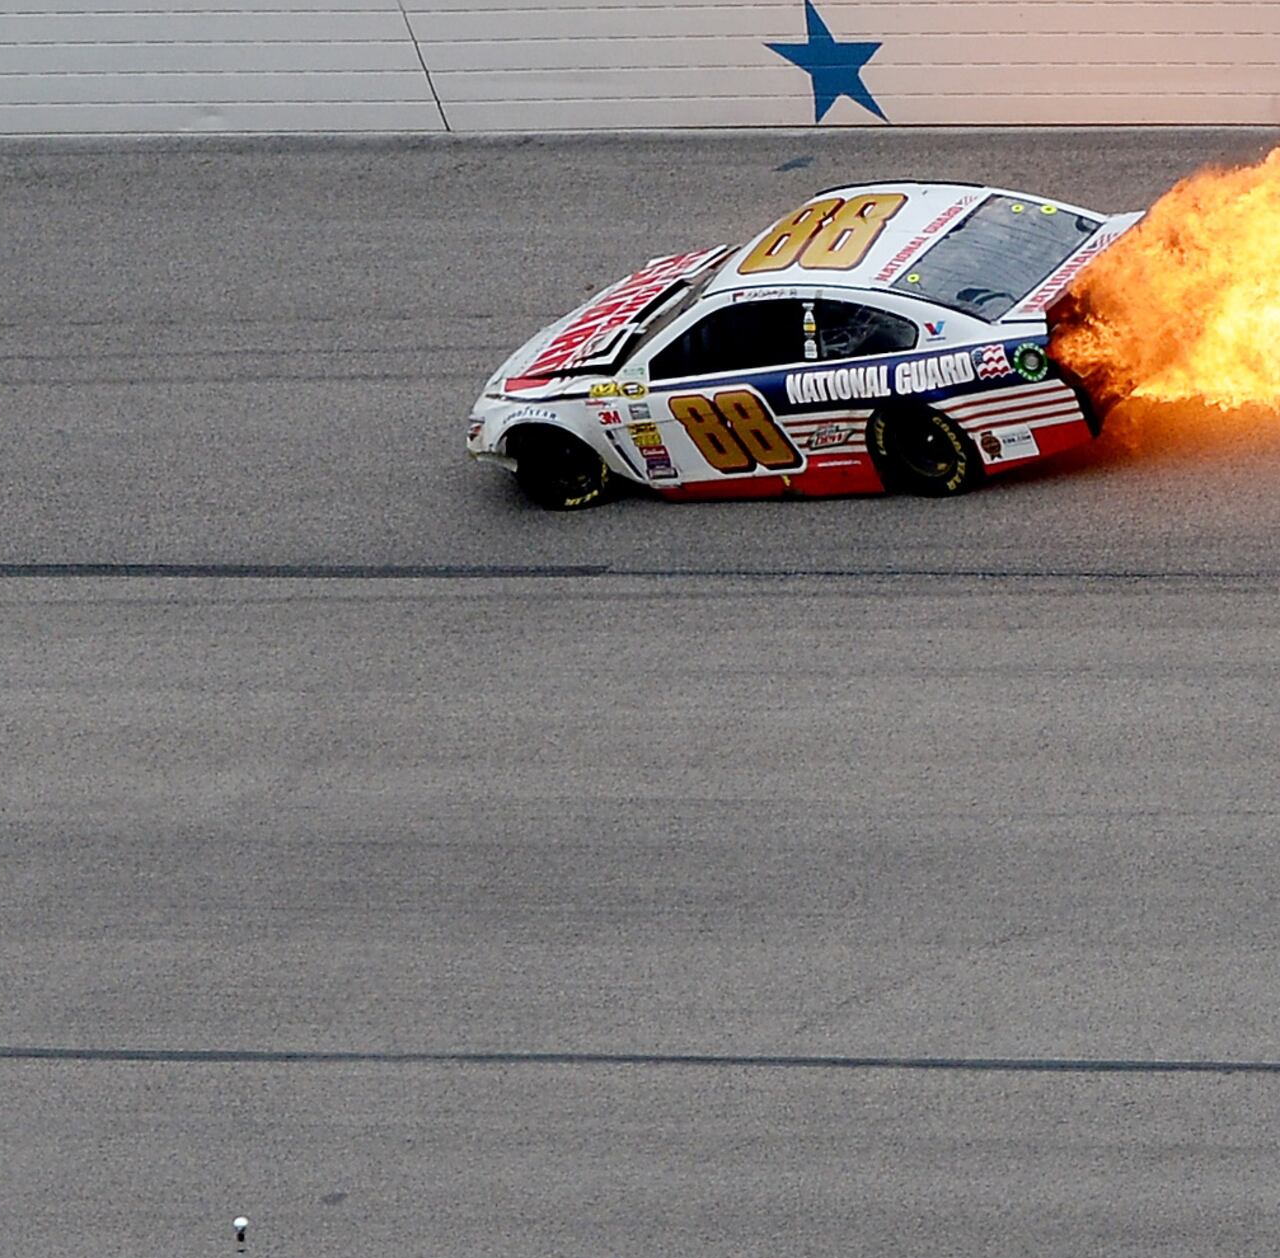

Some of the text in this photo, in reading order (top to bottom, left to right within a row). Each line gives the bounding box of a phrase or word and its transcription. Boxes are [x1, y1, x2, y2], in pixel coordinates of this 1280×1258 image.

[737, 194, 908, 275] 88
[874, 205, 964, 284] NATIONAL GUARD
[786, 351, 975, 405] NATIONAL GUARD
[598, 410, 622, 426] 3M
[668, 390, 804, 475] 88
